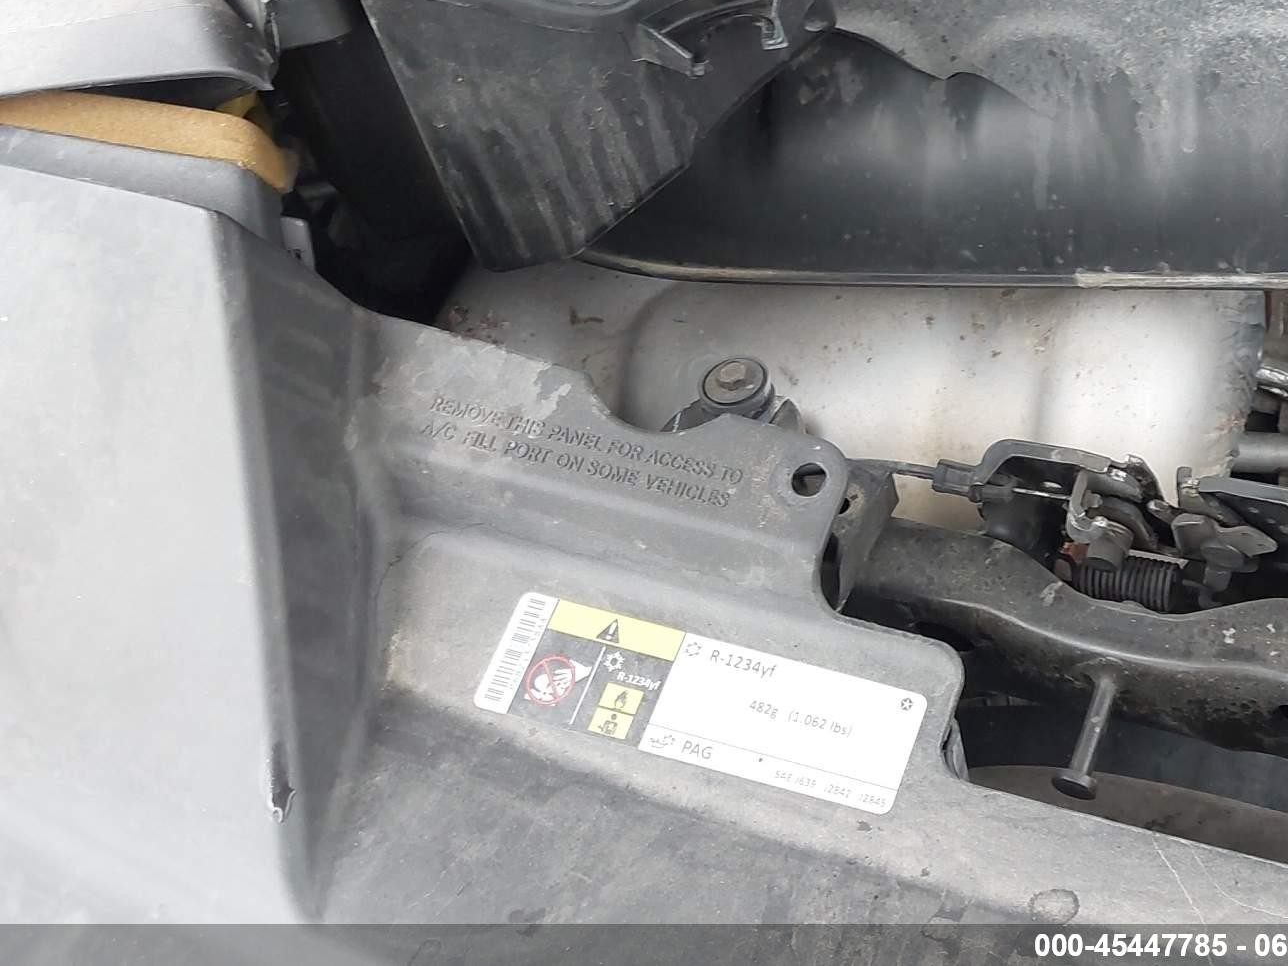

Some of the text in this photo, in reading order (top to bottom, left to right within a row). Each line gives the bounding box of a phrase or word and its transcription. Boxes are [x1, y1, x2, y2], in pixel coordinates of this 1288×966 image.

[429, 396, 744, 485] REMOVE THIS PANEL FOR ACCESS TO
[420, 420, 731, 508] A/C FILL PORT ON SOME VEHICLES
[617, 671, 662, 691] R-1234yf
[710, 649, 777, 679] R-1234yf
[748, 699, 779, 720] 482g
[829, 720, 853, 738] lbs)
[681, 739, 714, 761] PAG
